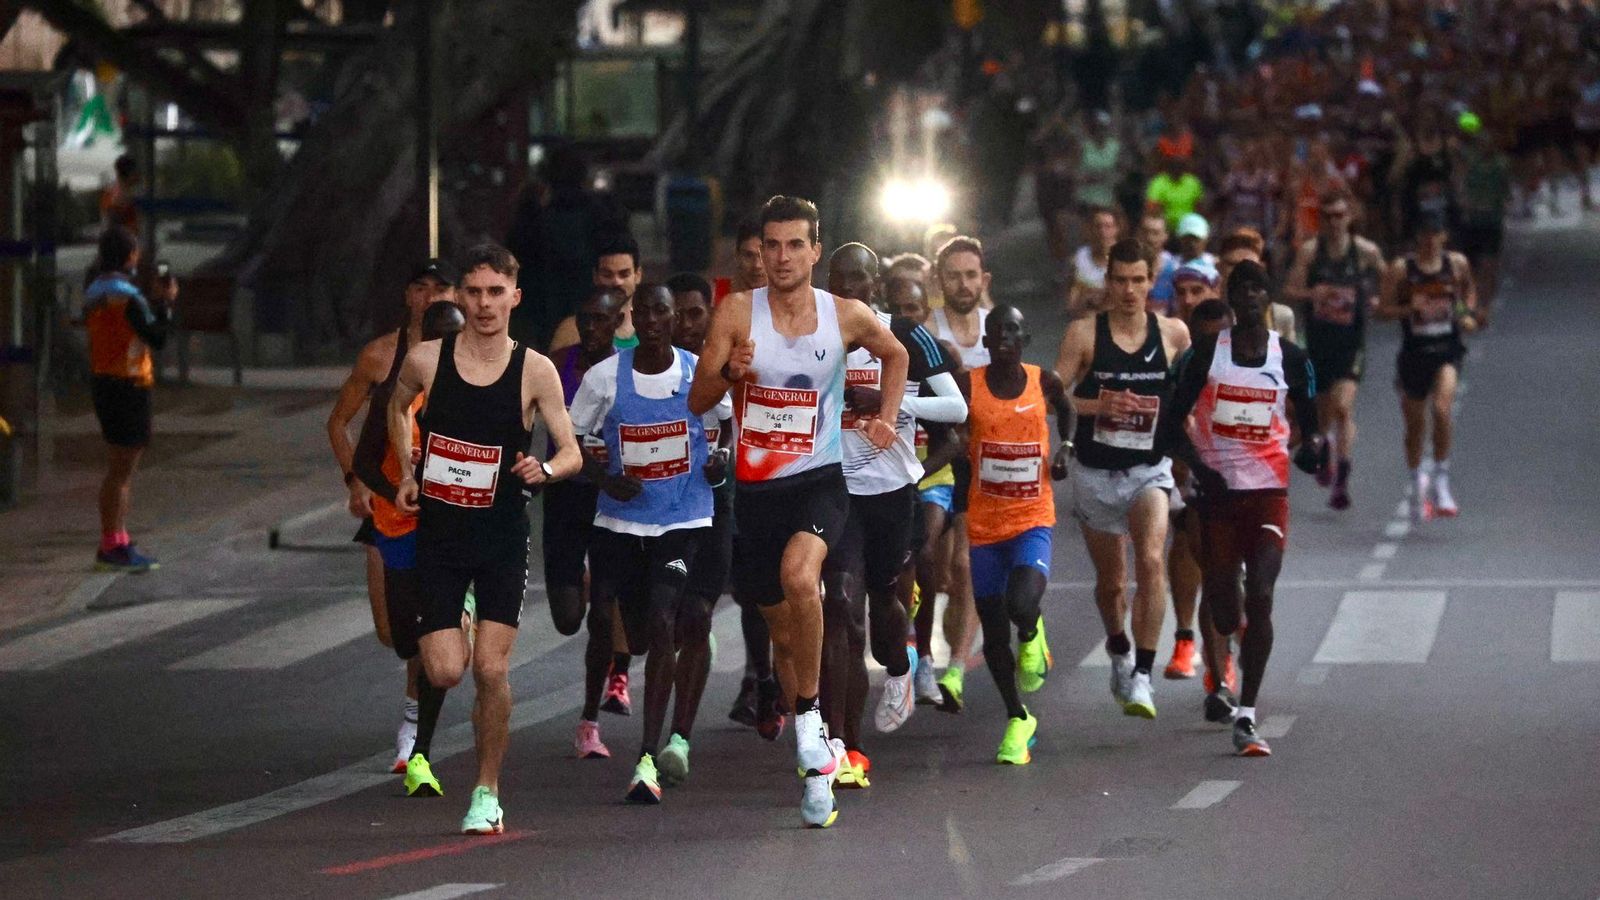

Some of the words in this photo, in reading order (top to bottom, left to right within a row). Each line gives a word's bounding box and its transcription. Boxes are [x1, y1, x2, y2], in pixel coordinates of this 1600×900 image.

[763, 390, 812, 402] GENERALI
[765, 412, 793, 422] PACER
[637, 424, 683, 436] GENERALI
[446, 443, 496, 459] GENERALI
[448, 466, 471, 477] PACER
